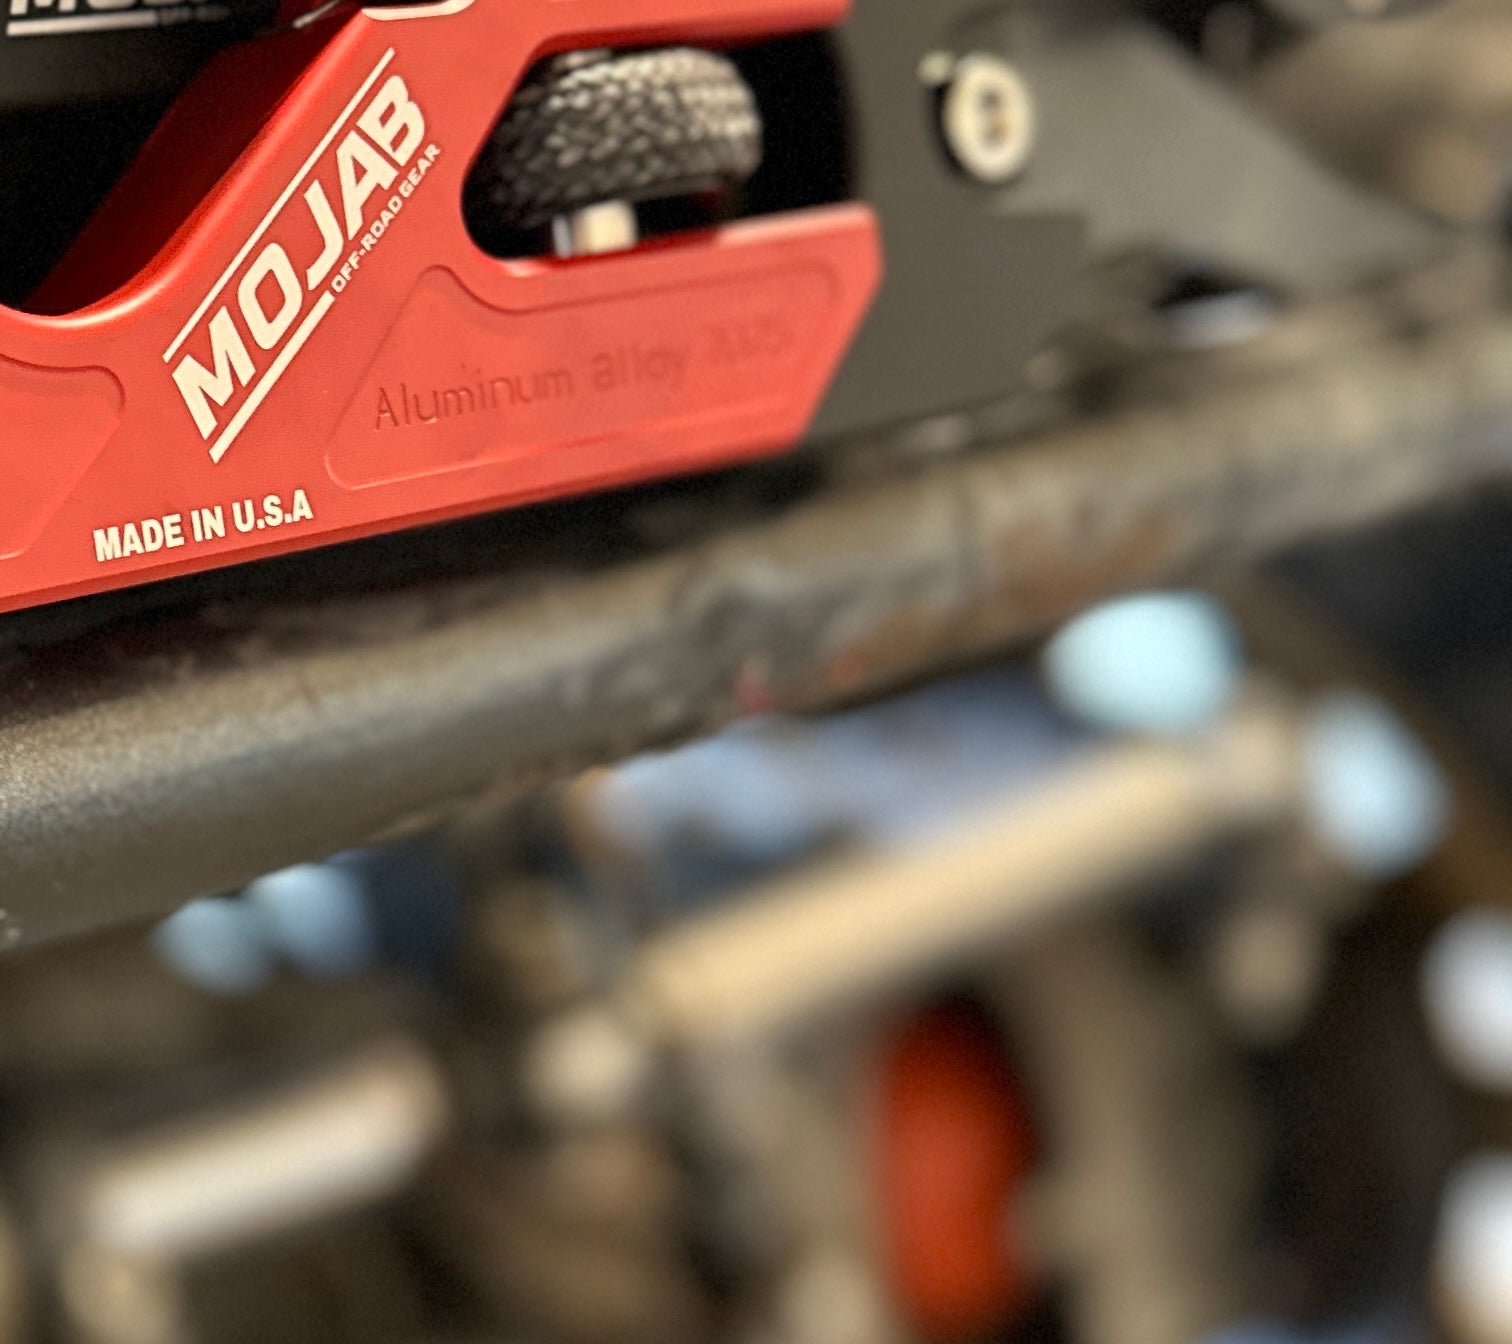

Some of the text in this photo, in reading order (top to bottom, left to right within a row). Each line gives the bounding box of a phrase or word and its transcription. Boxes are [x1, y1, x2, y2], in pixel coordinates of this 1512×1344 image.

[172, 75, 425, 440] MOJAB
[330, 144, 441, 293] OFF-ROAD GEAR
[373, 364, 575, 431] Aluminum
[93, 489, 314, 563] MADE IN U.S.A
